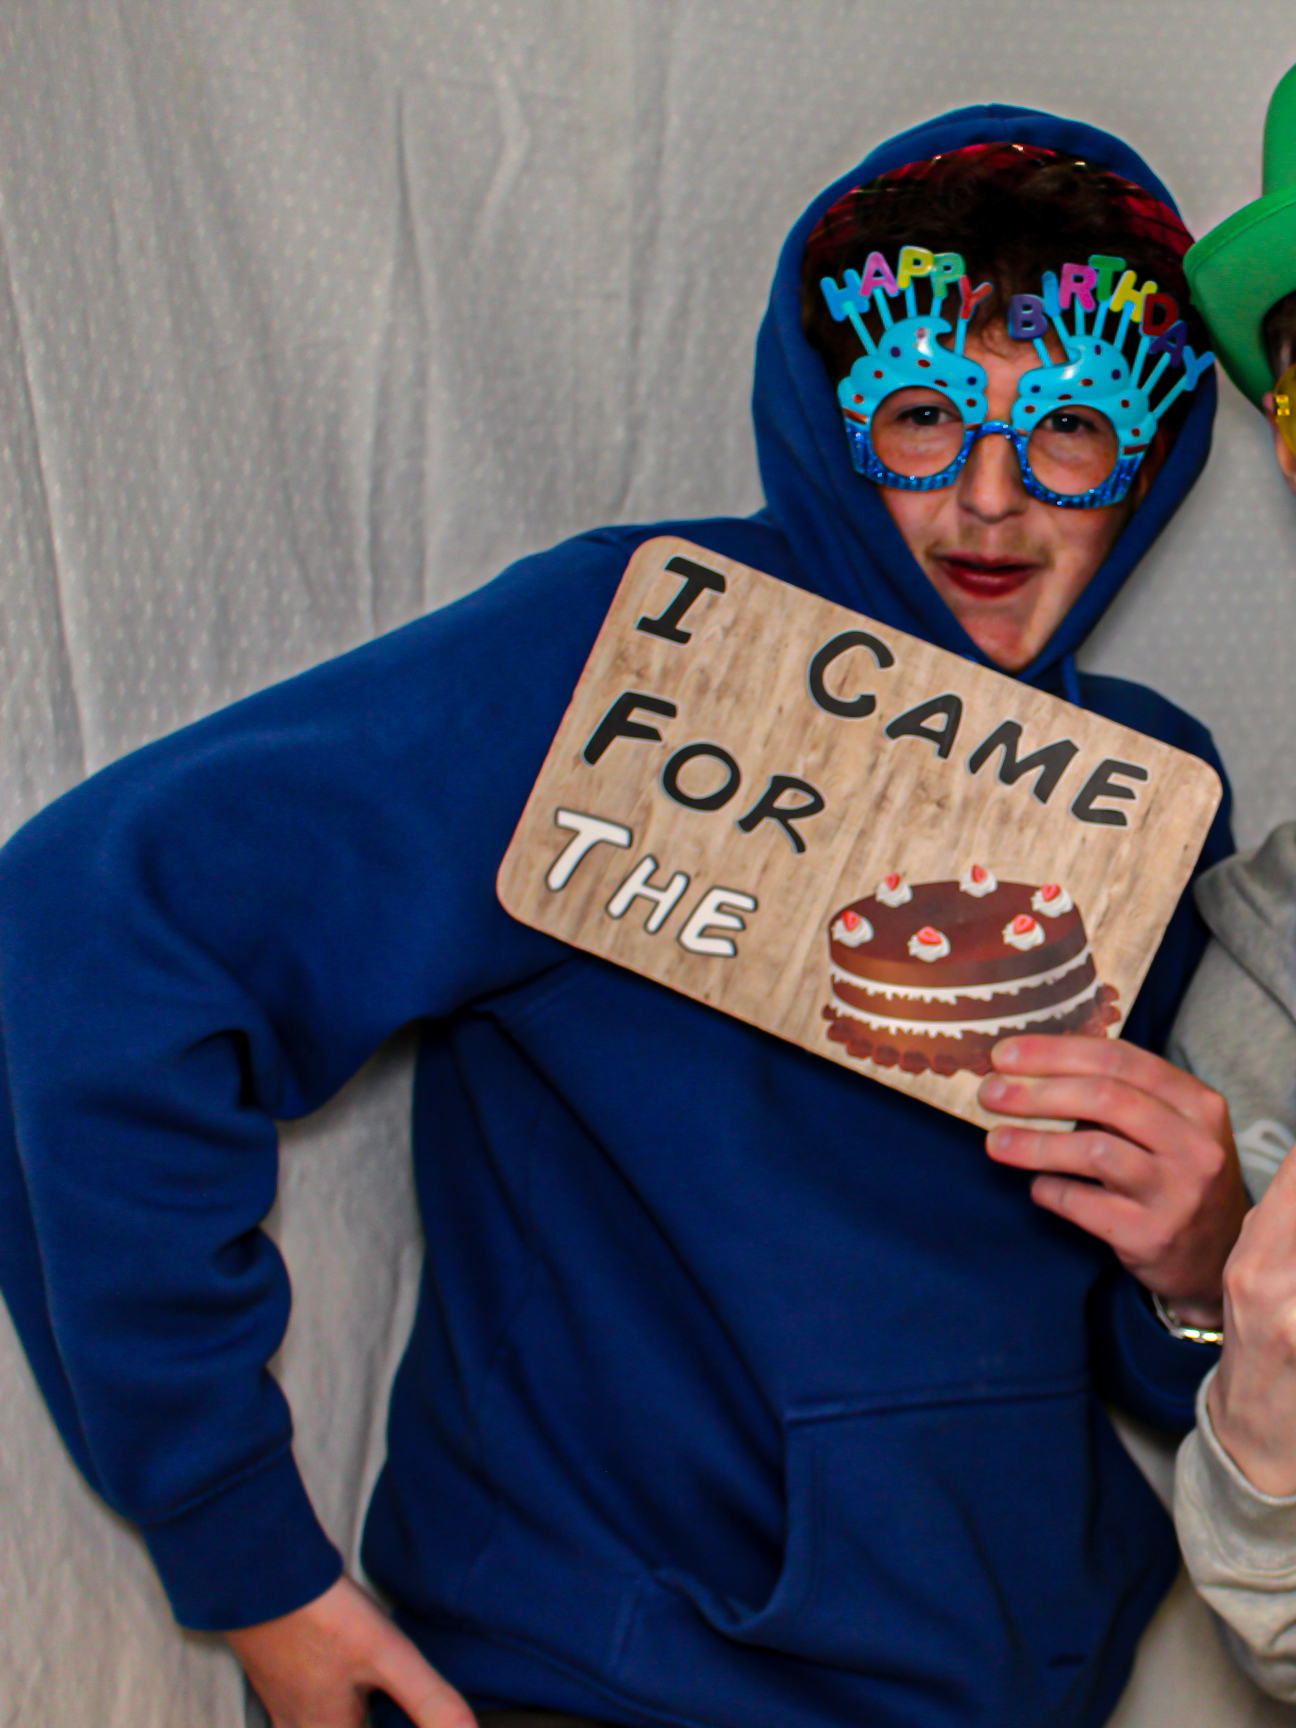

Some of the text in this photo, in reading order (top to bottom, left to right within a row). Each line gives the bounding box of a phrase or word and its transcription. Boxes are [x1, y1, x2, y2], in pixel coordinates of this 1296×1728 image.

[821, 247, 1214, 390] HAPPY BIRTHDAY
[635, 556, 1149, 826] I CAME
[583, 691, 825, 854] FOR
[545, 808, 757, 956] THE
